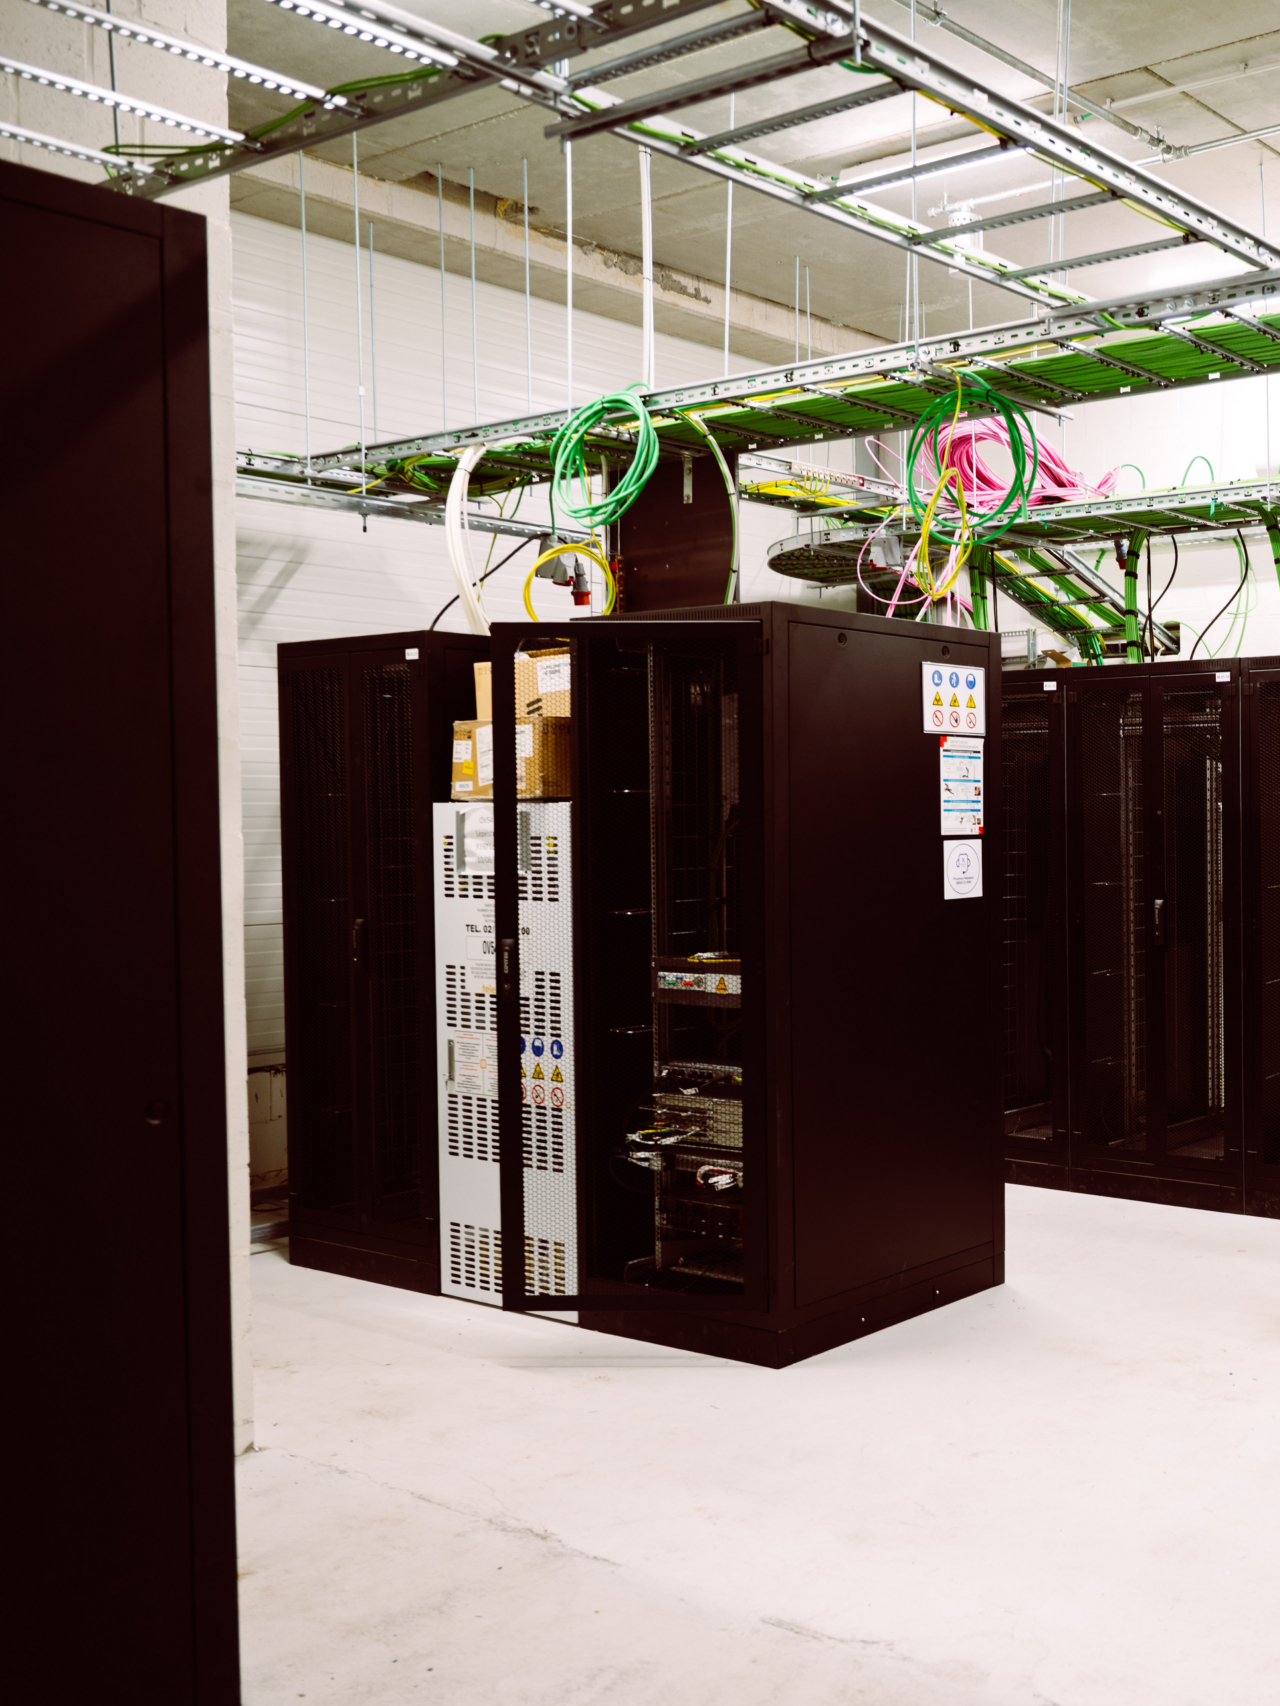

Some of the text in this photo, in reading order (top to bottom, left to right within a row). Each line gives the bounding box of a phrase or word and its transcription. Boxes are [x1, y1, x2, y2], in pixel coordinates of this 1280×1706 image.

[465, 924, 482, 933] TEL.
[482, 940, 495, 955] OV5
[482, 984, 496, 994] tele
